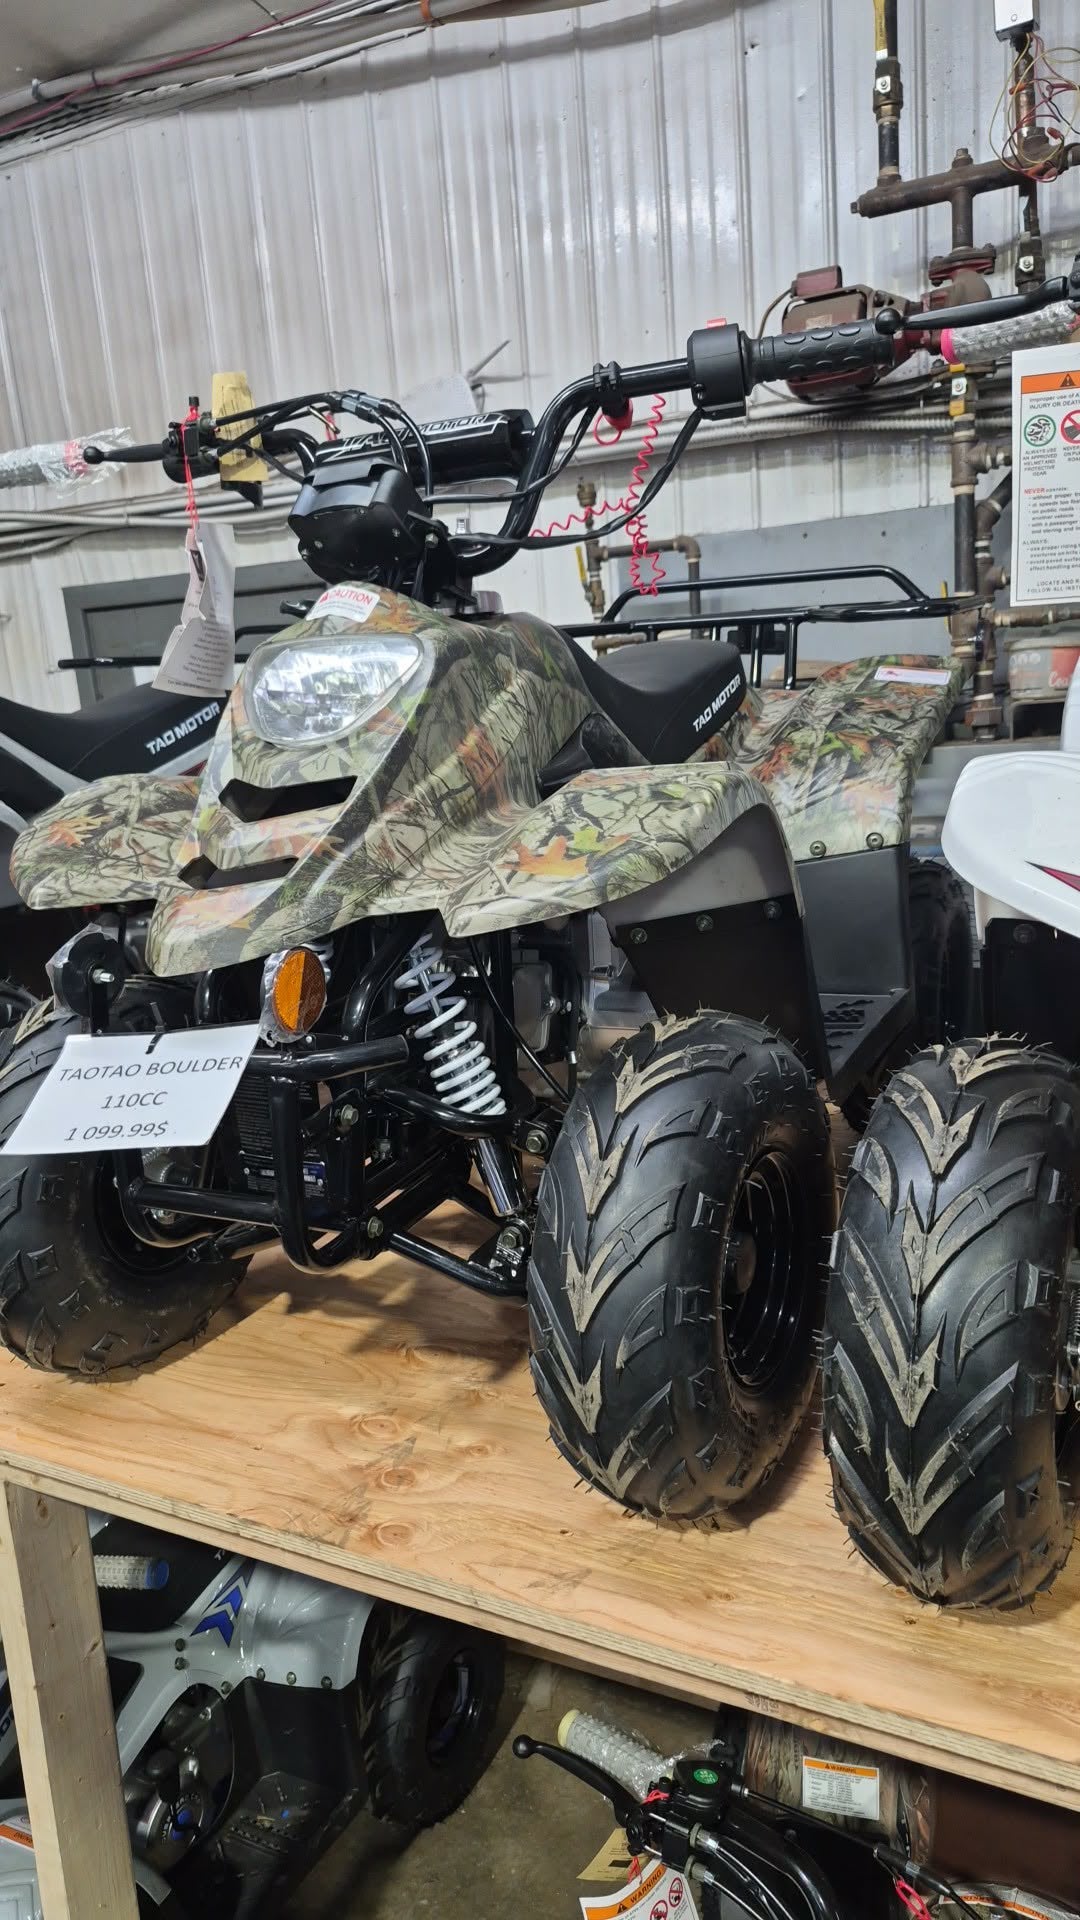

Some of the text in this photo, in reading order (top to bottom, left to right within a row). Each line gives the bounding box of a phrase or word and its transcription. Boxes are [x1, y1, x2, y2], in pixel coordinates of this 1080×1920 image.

[693, 673, 741, 733] TAO MOTOR
[146, 701, 220, 755] TAO MOTOR
[59, 1056, 243, 1082] TAOTAO BOULDER
[101, 1091, 169, 1109] 110CC
[831, 1763, 857, 1774] WARNING
[630, 1869, 662, 1904] WARNING
